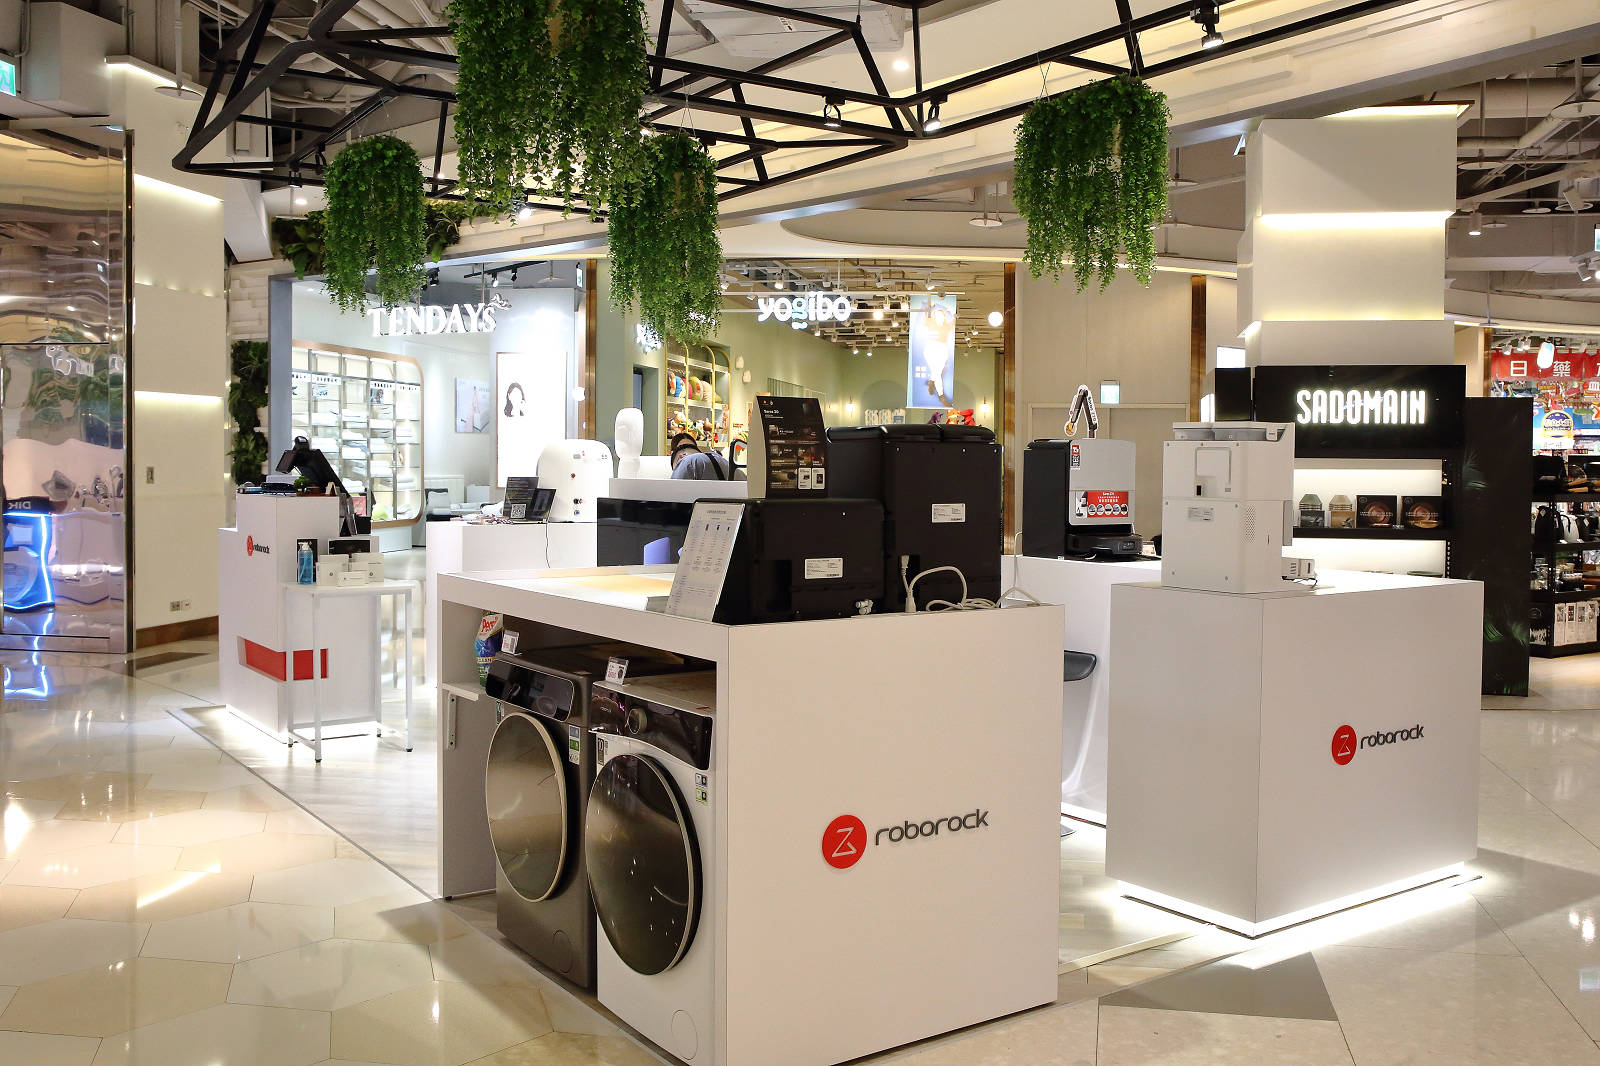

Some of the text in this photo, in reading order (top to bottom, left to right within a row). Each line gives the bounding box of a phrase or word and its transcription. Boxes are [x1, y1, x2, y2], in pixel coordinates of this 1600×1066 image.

[366, 302, 497, 337] TENDAYS
[757, 291, 851, 329] yogibo
[1296, 389, 1426, 425] SADOMAIN
[1360, 724, 1425, 750] roborock
[874, 808, 990, 846] roborock
